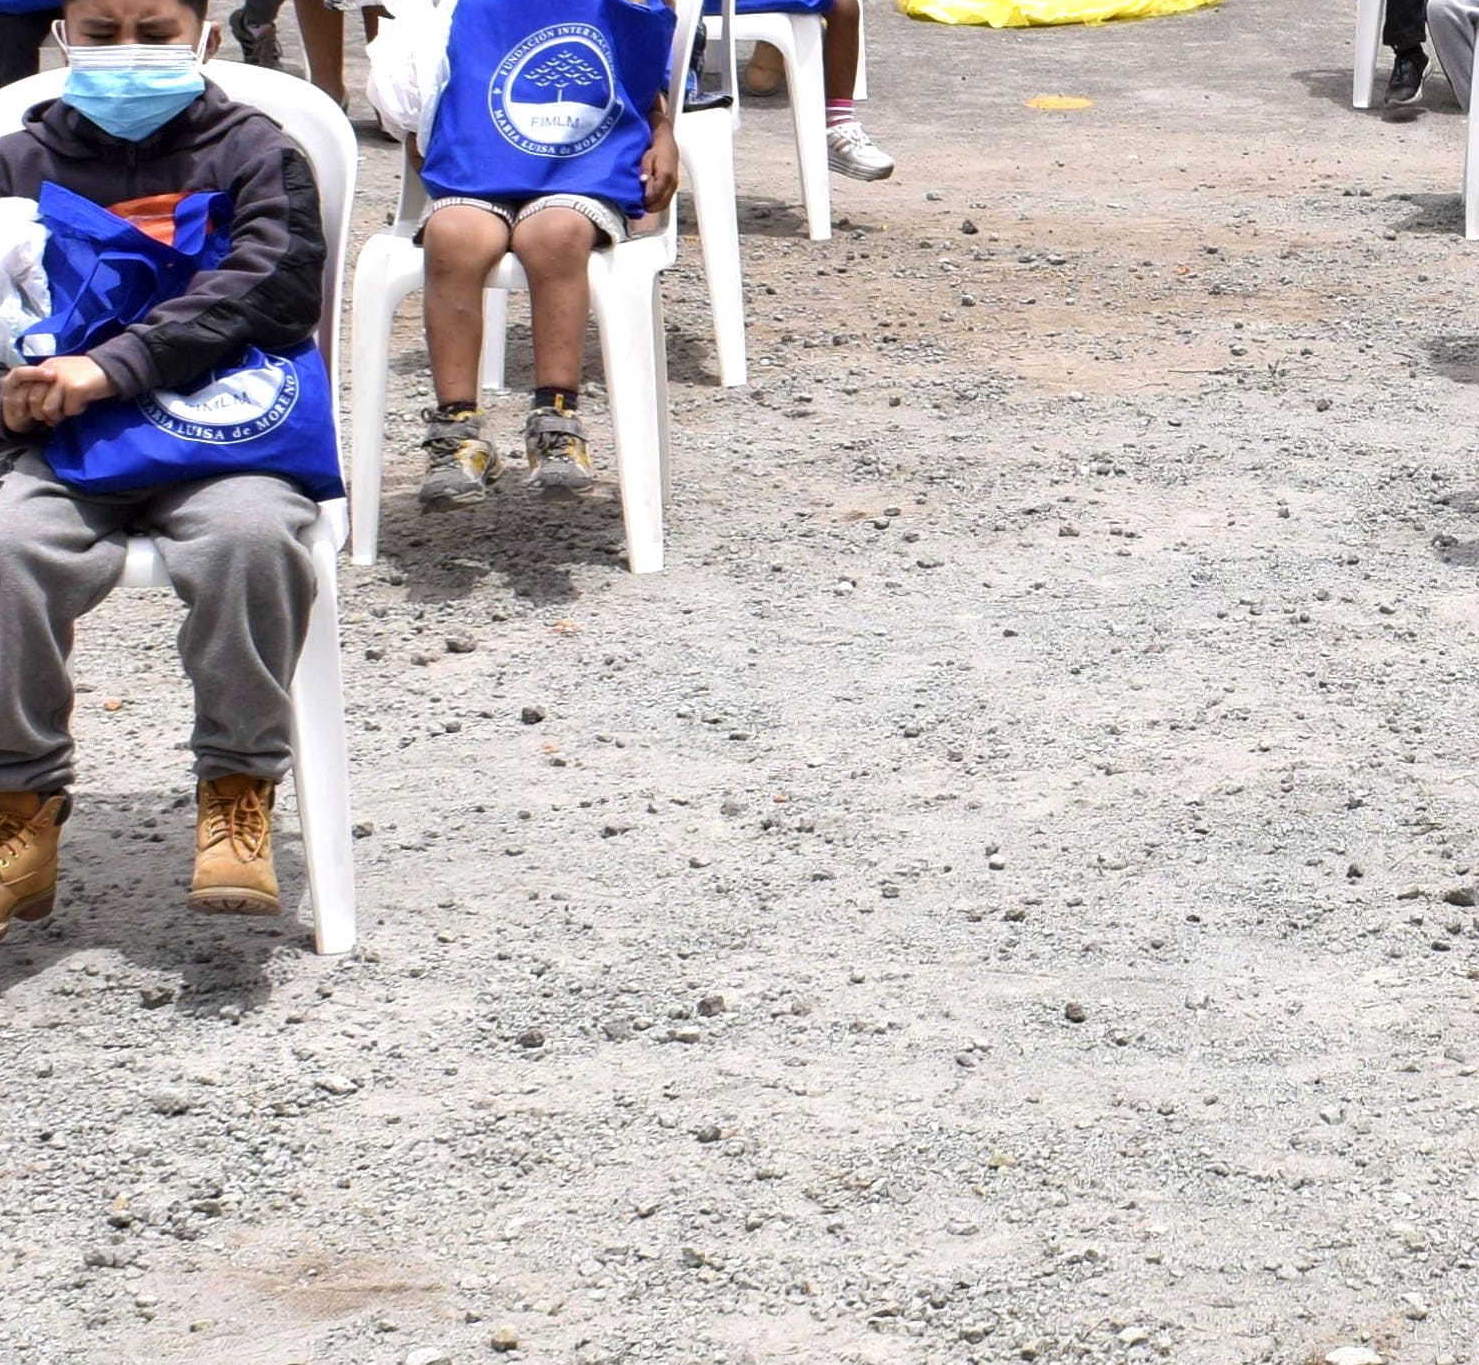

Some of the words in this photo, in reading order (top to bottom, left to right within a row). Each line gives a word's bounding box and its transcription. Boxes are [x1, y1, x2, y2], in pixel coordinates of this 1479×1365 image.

[531, 116, 579, 129] FIMLM
[178, 425, 225, 440] LUISA
[233, 426, 251, 438] de
[256, 376, 297, 431] MORENO
